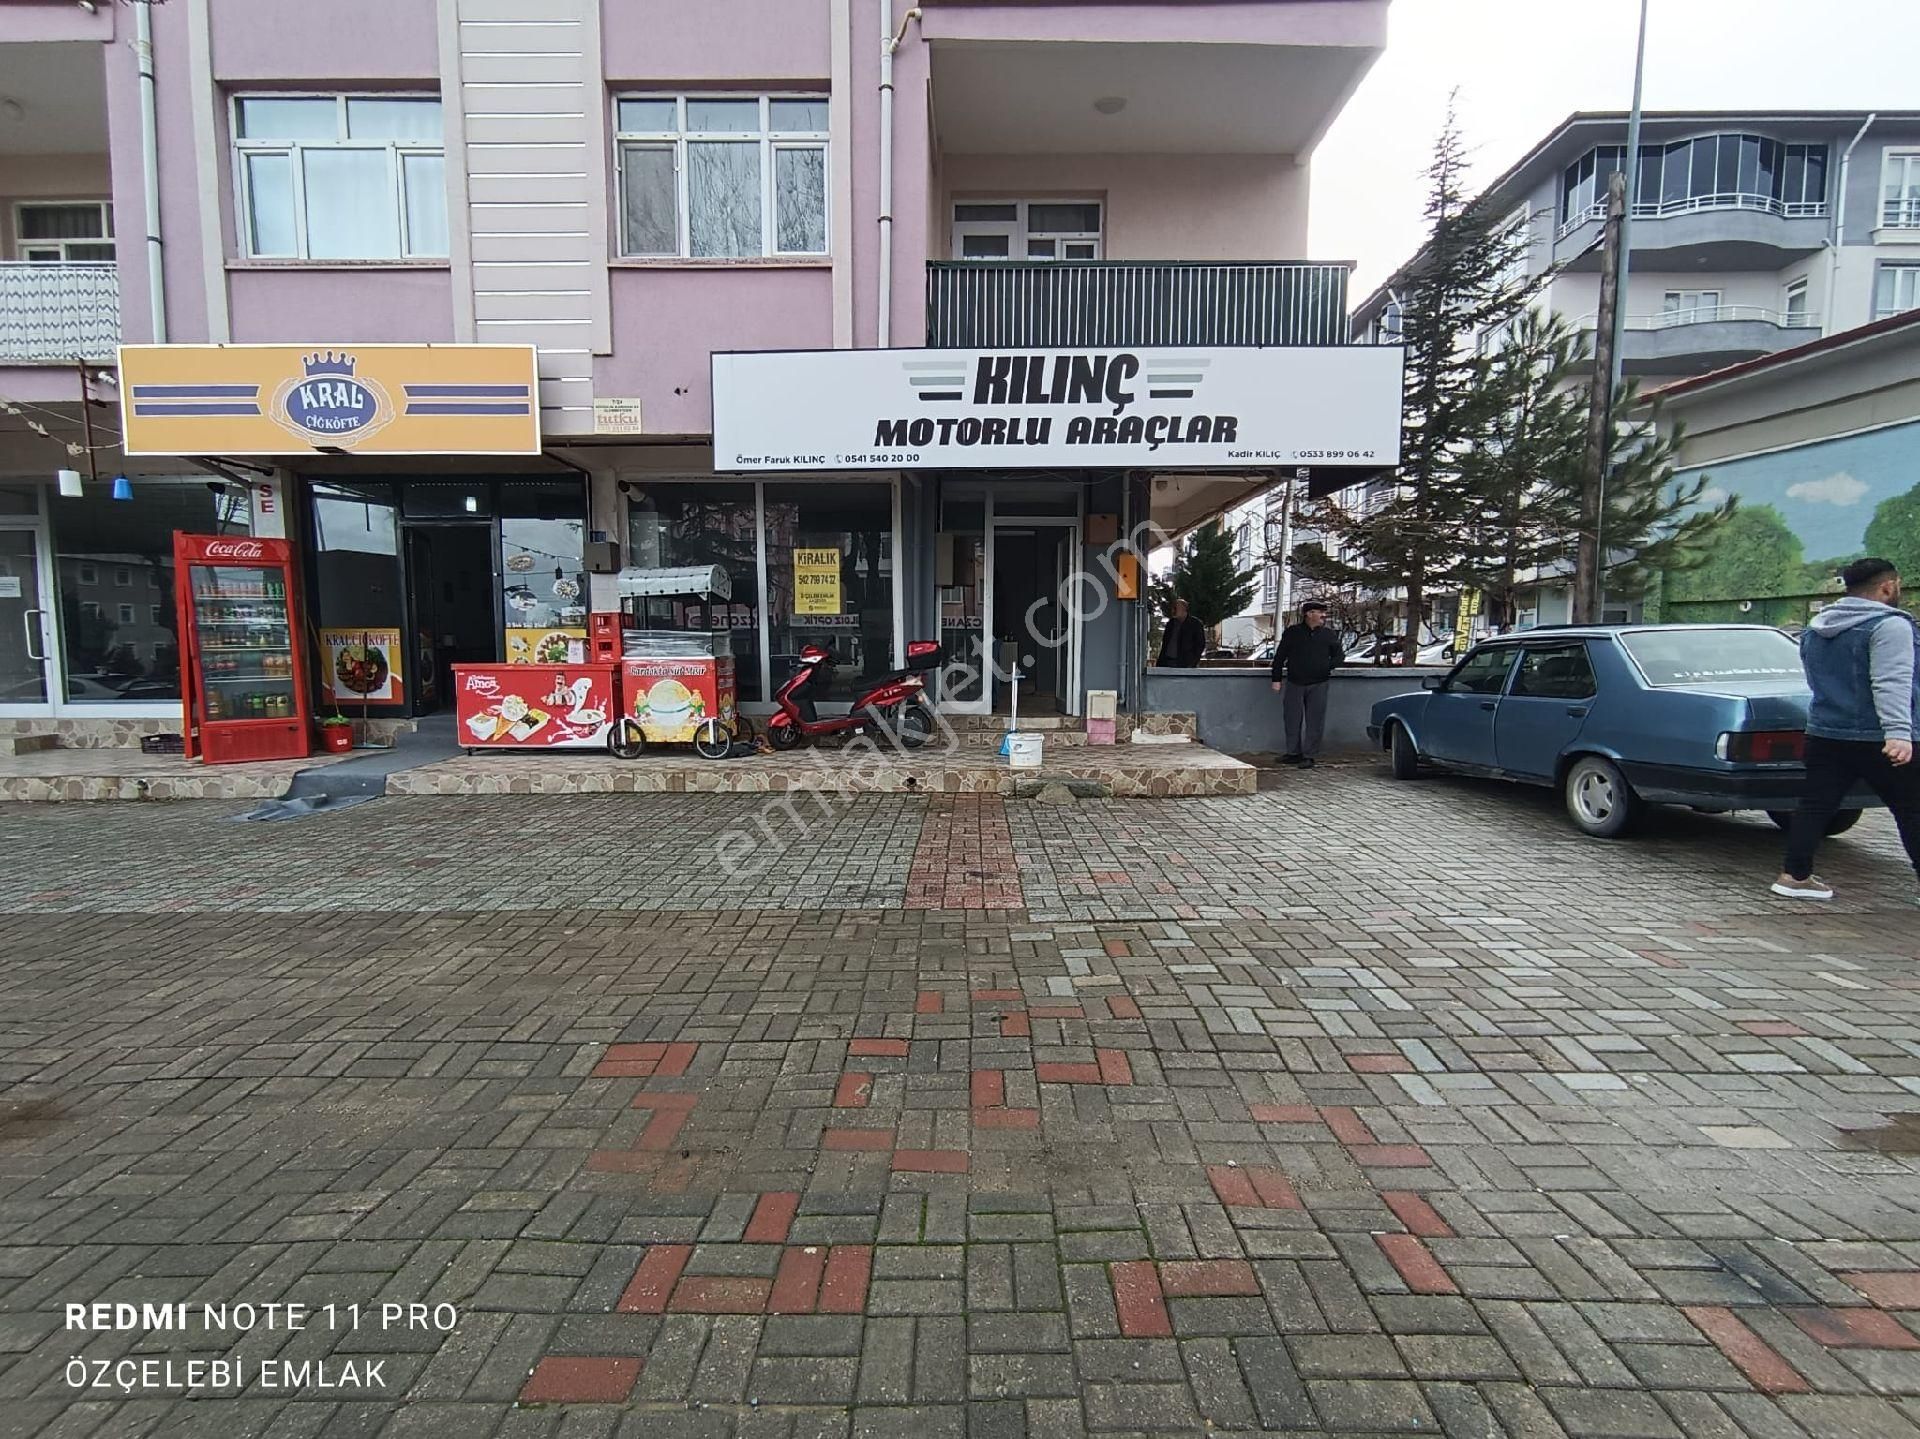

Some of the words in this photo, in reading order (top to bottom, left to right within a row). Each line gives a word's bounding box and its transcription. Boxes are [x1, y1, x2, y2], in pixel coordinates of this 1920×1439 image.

[300, 382, 364, 409] KRAL
[973, 354, 1139, 415] KILINÇ
[874, 417, 1051, 447] MOTORLU
[1065, 415, 1238, 451] ARAÇLAR
[736, 453, 762, 464] Ömer
[764, 455, 791, 464] Faruk
[793, 455, 825, 465] KILINÇ
[845, 454, 868, 463] 0541
[870, 454, 888, 463] 540
[891, 454, 904, 463] 20
[906, 454, 920, 462] 00
[1228, 450, 1253, 458] Kadir
[1255, 450, 1281, 460] KILIÇ
[1299, 450, 1324, 458] 0533
[1326, 450, 1344, 458] 899
[1347, 450, 1360, 458] 06
[1362, 450, 1375, 458] 42
